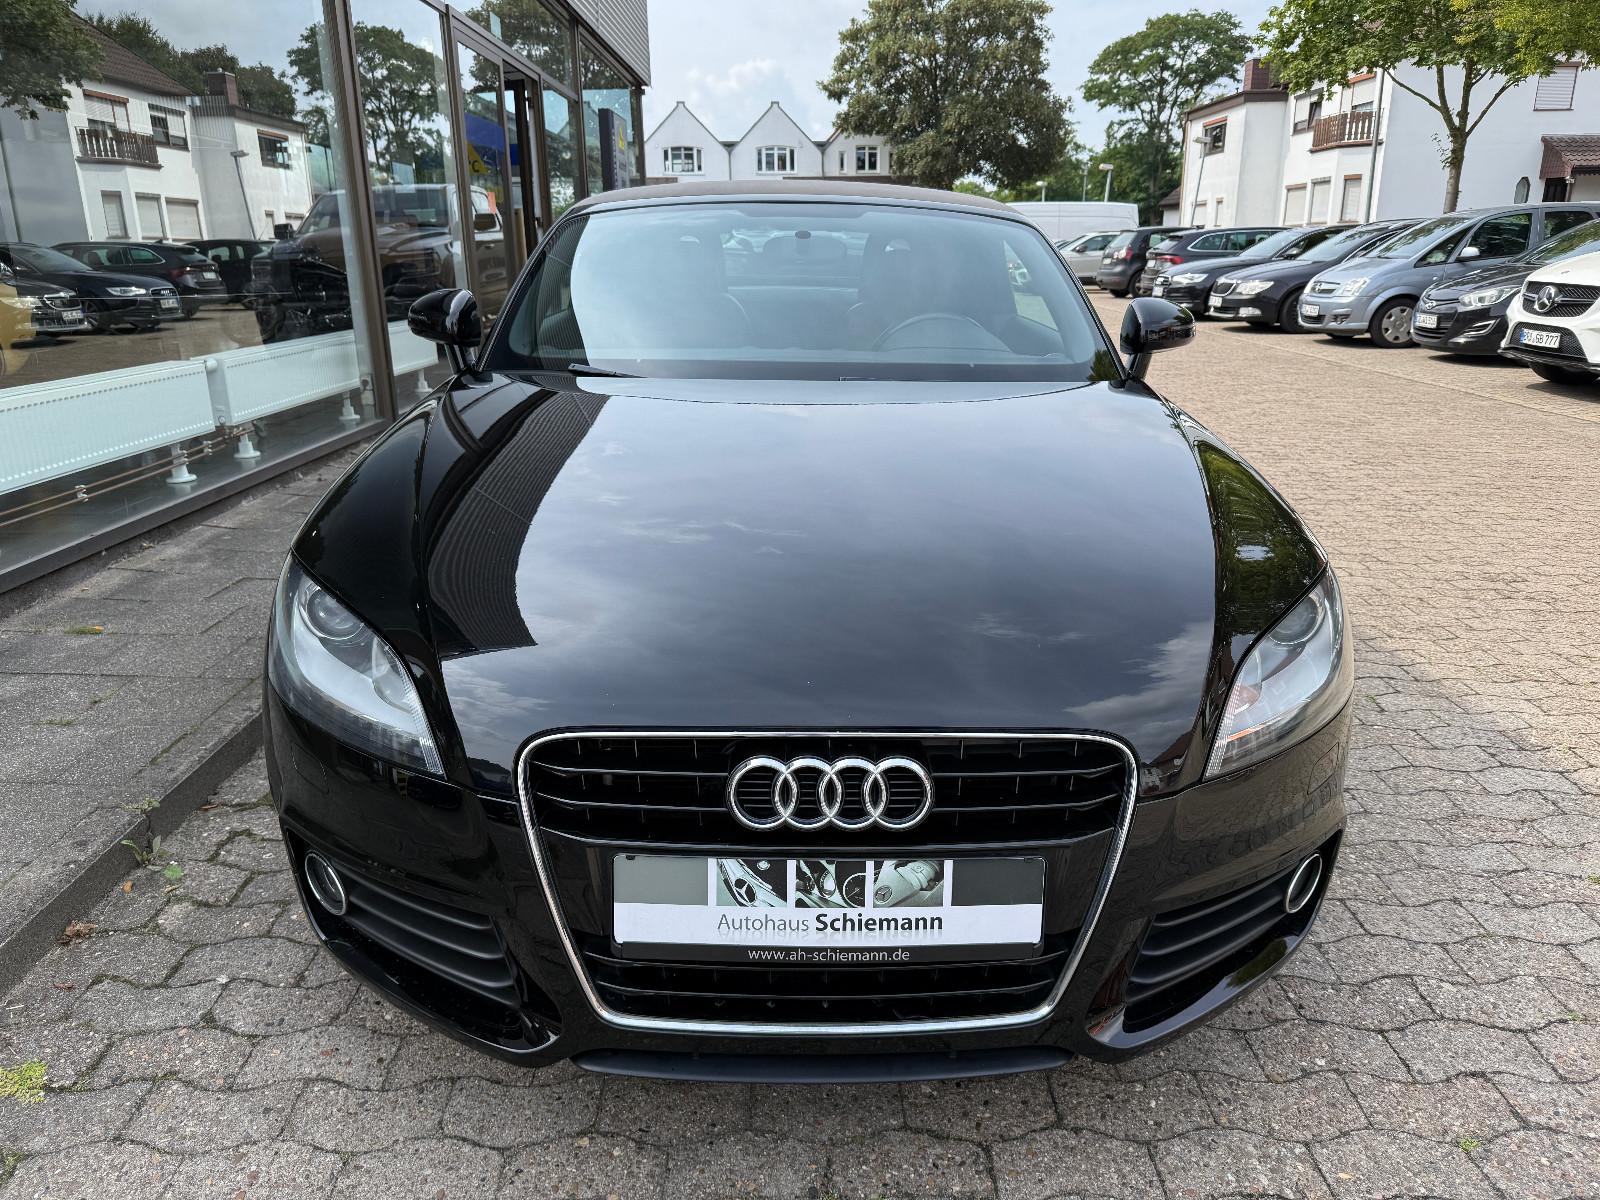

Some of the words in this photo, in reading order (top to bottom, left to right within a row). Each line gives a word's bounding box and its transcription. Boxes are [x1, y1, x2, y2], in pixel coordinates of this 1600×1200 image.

[1544, 335, 1559, 346] 777
[717, 914, 809, 932] Autohaus
[815, 913, 943, 932] Schiemann
[748, 949, 910, 962] www.ah-schiemann.de
